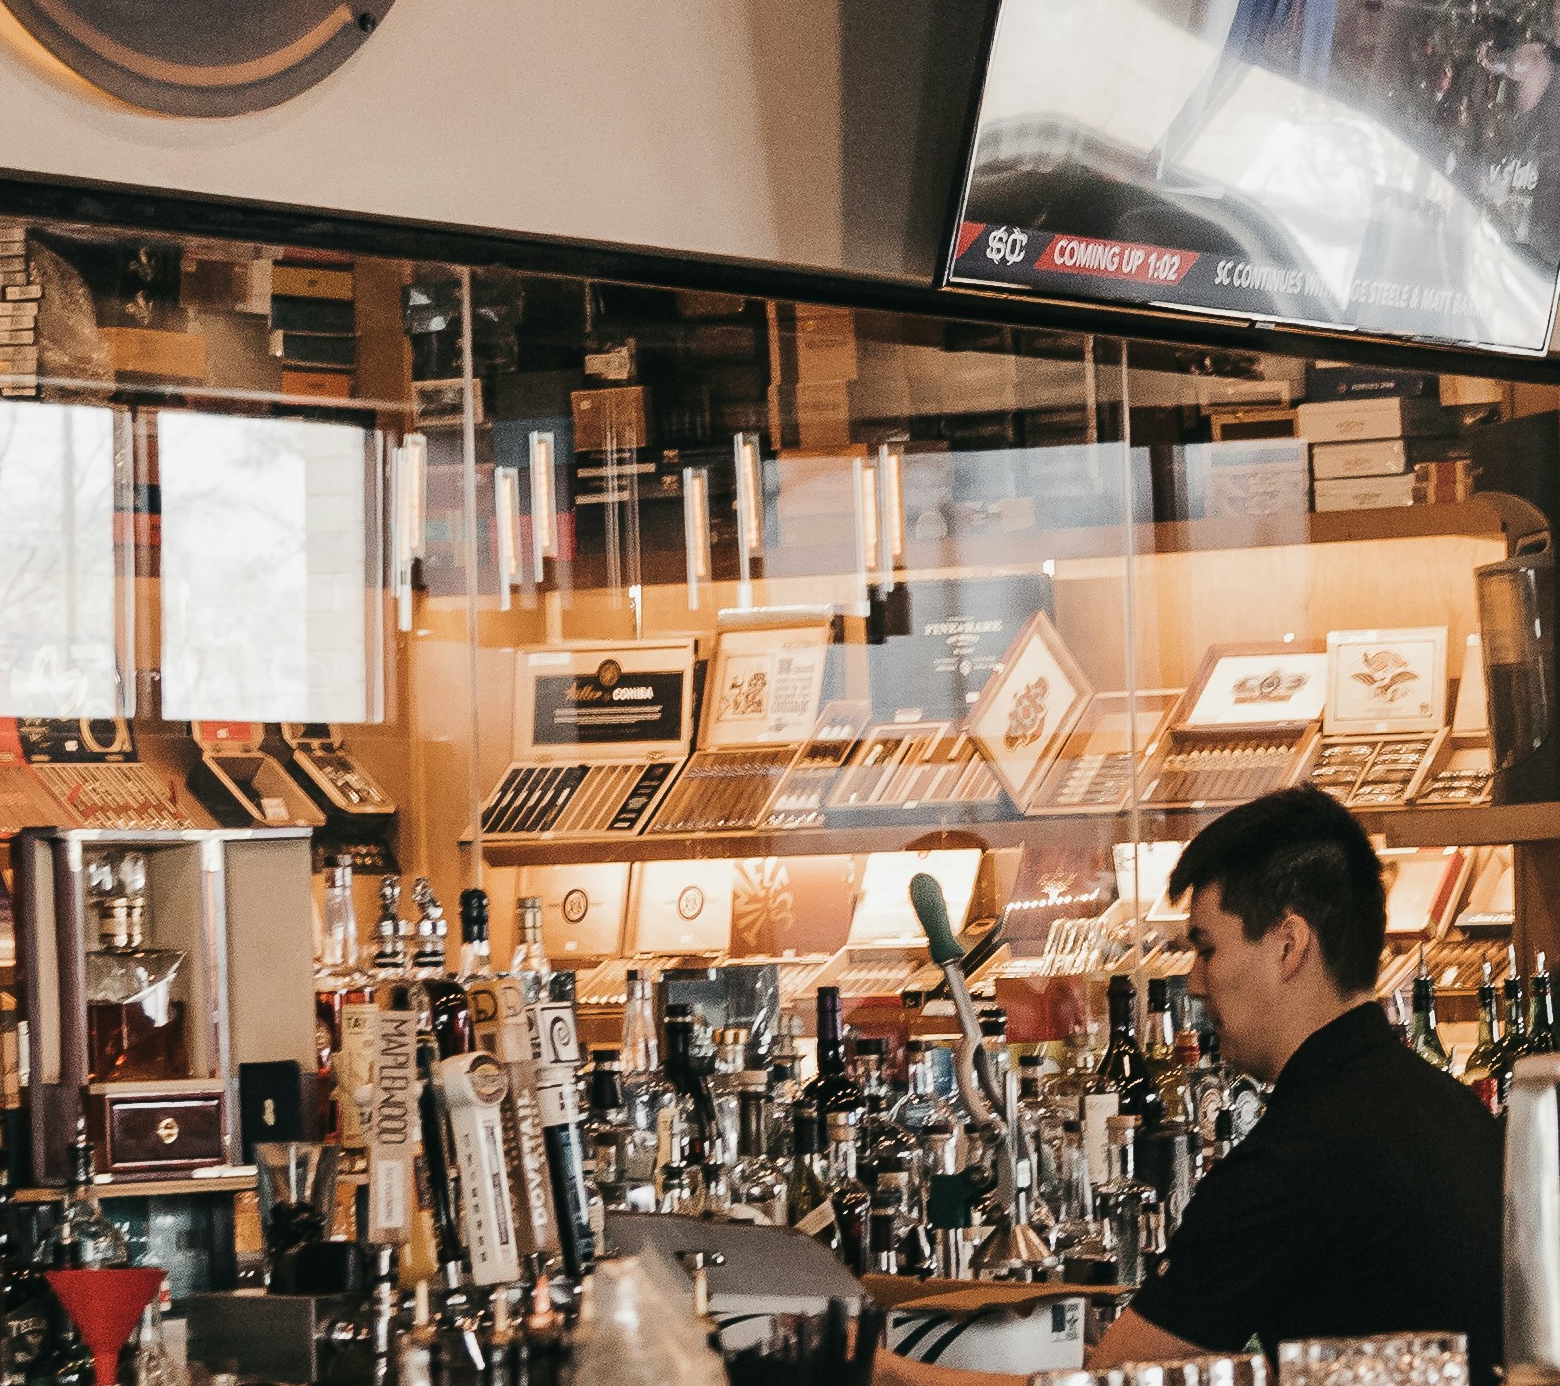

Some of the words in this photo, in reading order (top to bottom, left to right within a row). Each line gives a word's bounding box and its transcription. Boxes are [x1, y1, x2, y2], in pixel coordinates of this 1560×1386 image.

[1054, 239, 1120, 272] COMING
[1122, 249, 1145, 274] UP
[1146, 252, 1182, 281] 1:02
[1214, 260, 1235, 286] SC
[1233, 264, 1304, 295] CONTINUES
[1368, 281, 1409, 309] STEELE
[377, 1016, 411, 1146] MAPLEWOOD
